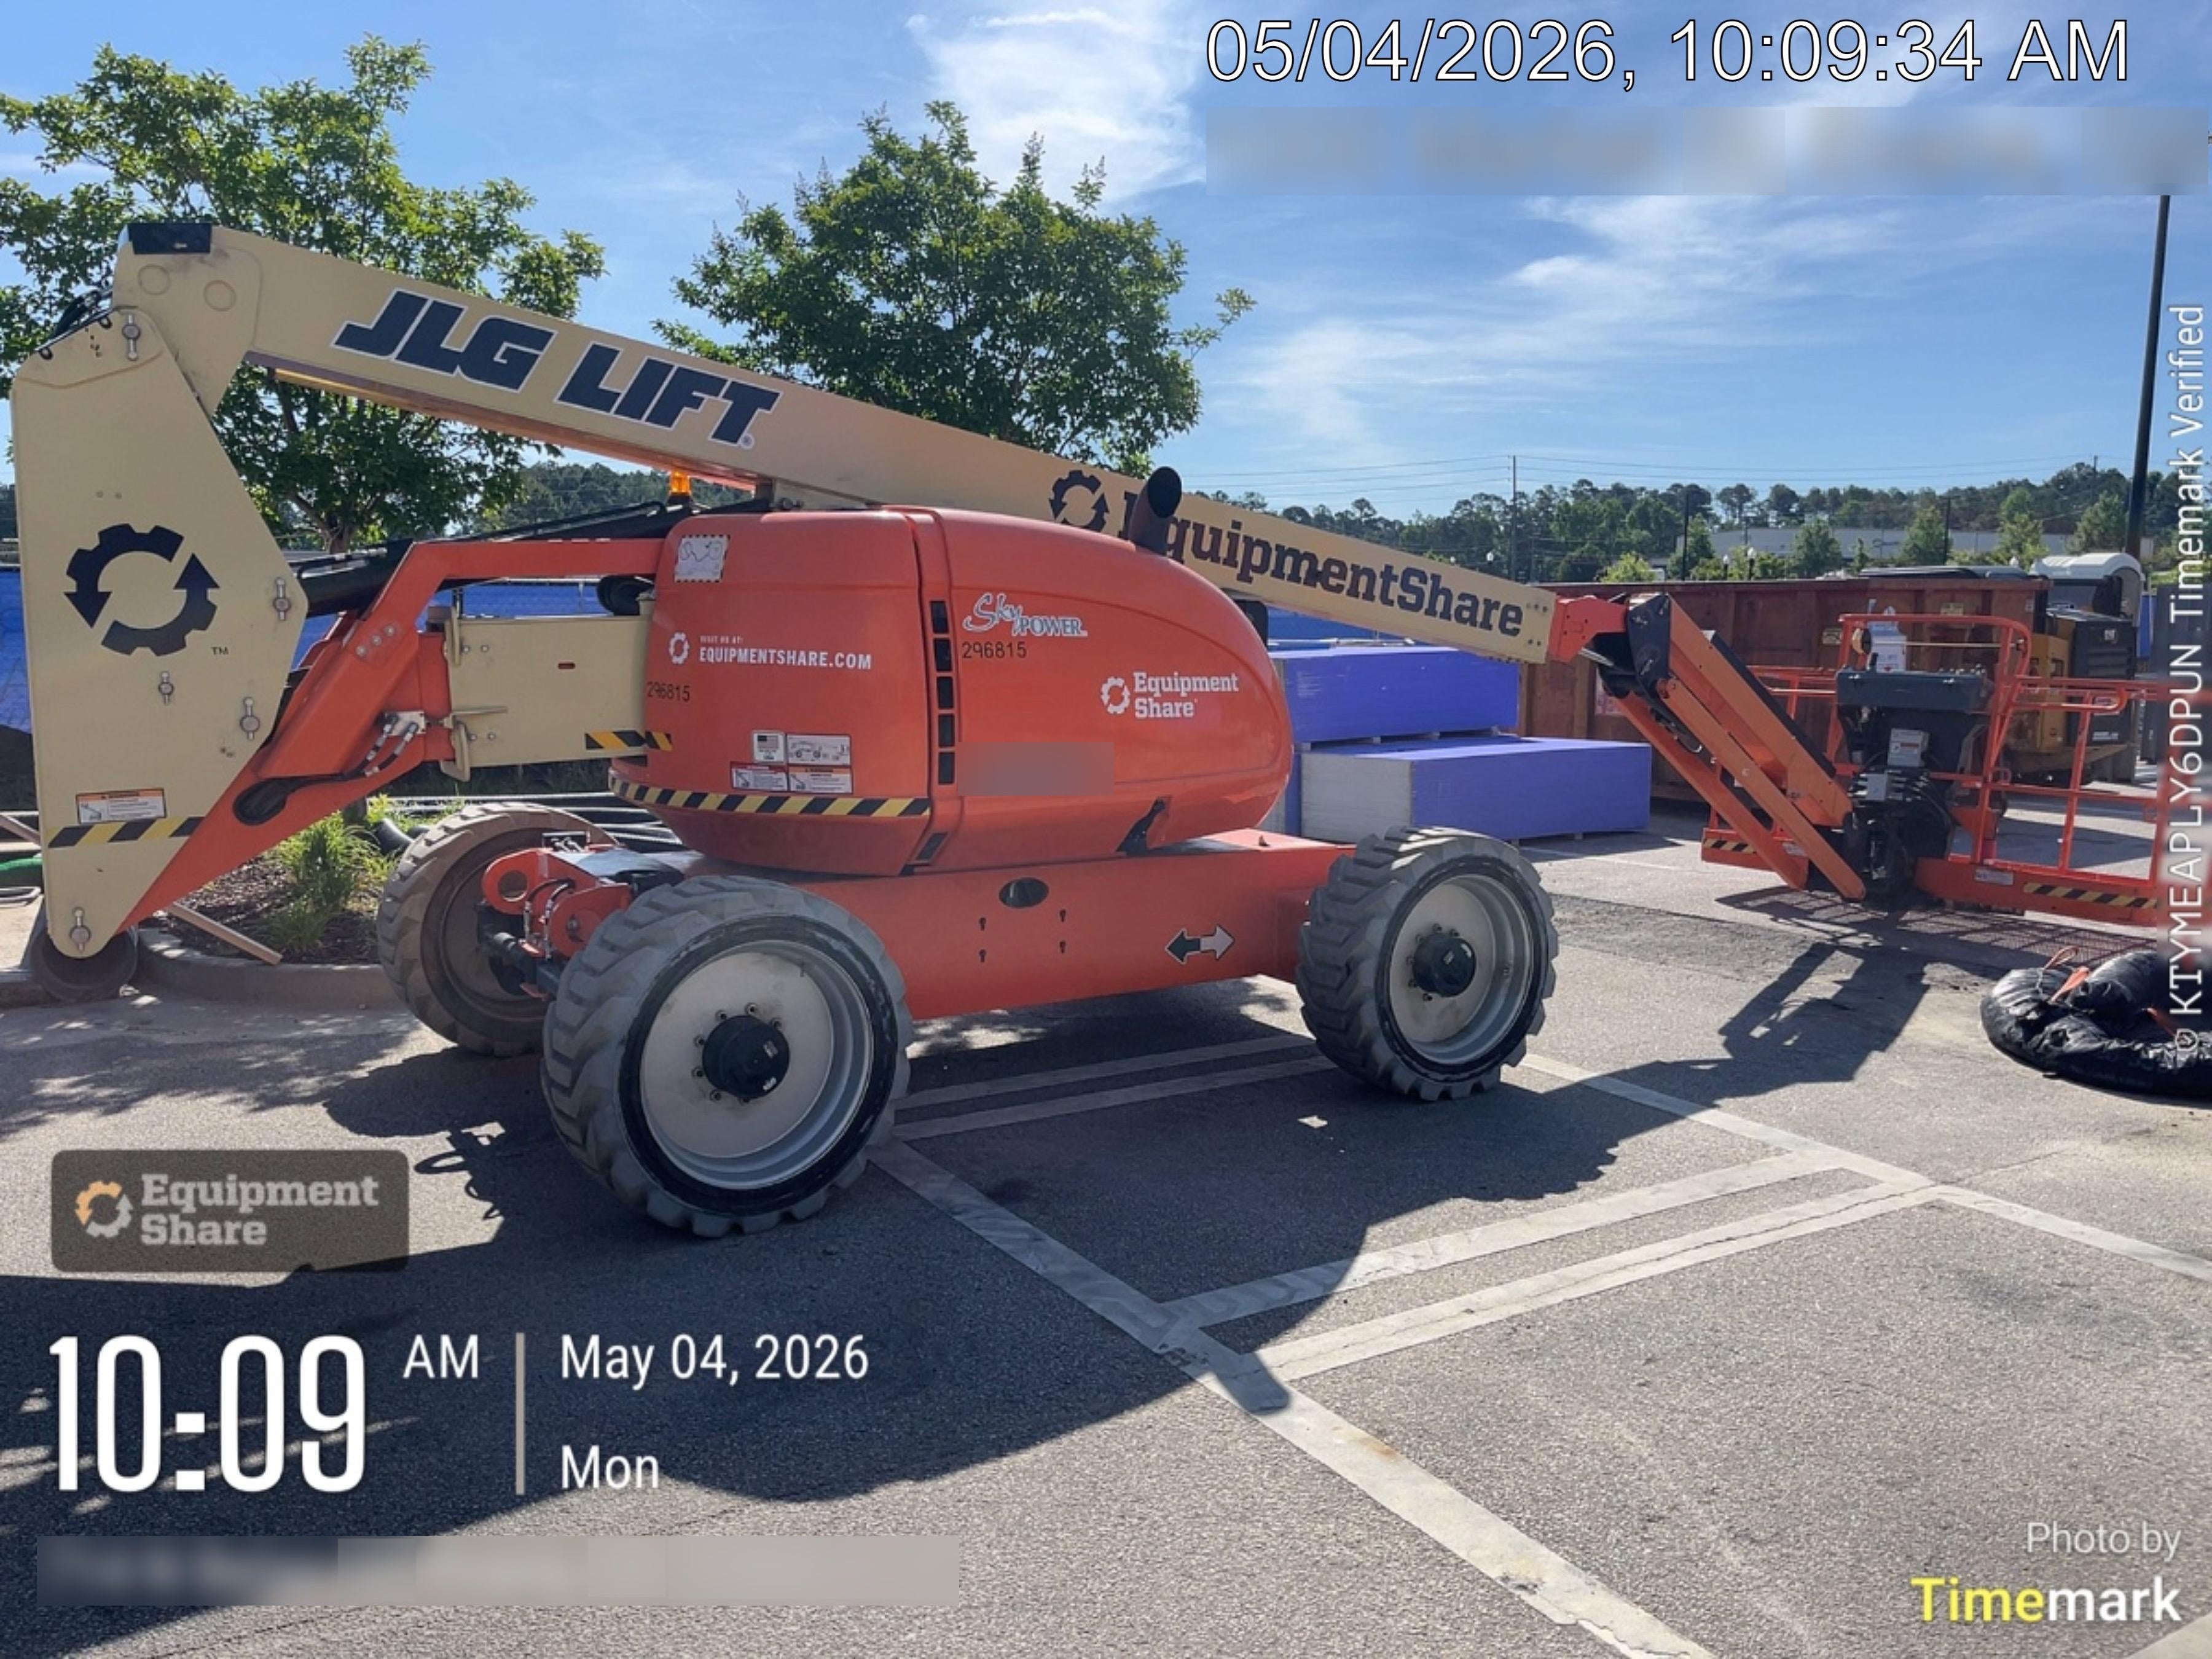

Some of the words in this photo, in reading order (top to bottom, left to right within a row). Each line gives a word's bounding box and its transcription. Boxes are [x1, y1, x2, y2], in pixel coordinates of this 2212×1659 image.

[331, 288, 557, 393] JLG
[554, 342, 783, 445] LIFT
[1118, 491, 1524, 637] quipmentShare
[699, 647, 871, 669] EQUIPMENTSHARE.COM
[961, 641, 1027, 659] 296815
[646, 680, 691, 702] 296815
[1134, 672, 1239, 698] Equipment
[1135, 696, 1194, 718] Share
